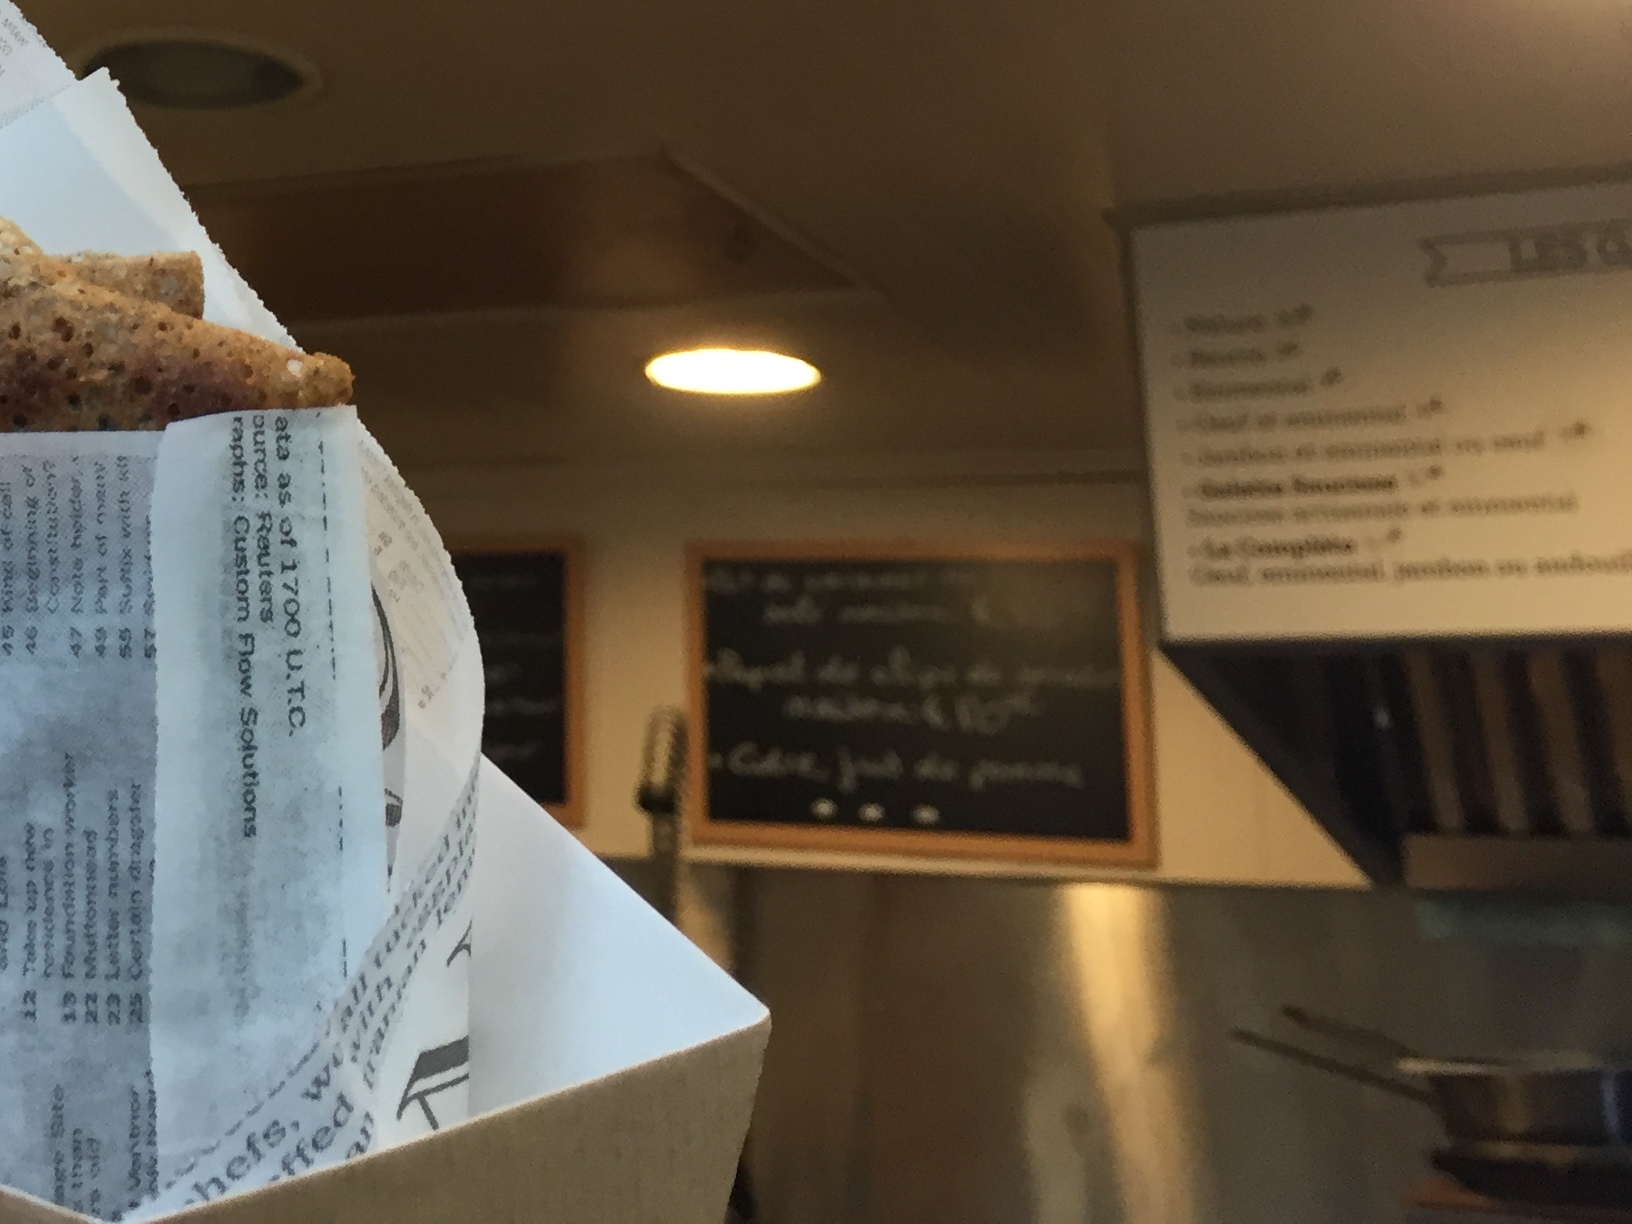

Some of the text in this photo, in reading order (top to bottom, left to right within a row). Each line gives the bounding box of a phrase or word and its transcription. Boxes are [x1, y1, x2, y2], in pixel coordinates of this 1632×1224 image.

[274, 416, 294, 462] ata
[252, 414, 277, 624] ource: Reuters
[230, 416, 262, 839] raphs: Custom Flow Solutions
[280, 559, 303, 639] 1700
[286, 648, 307, 738] U.T.C.
[60, 841, 77, 980] Foundation
